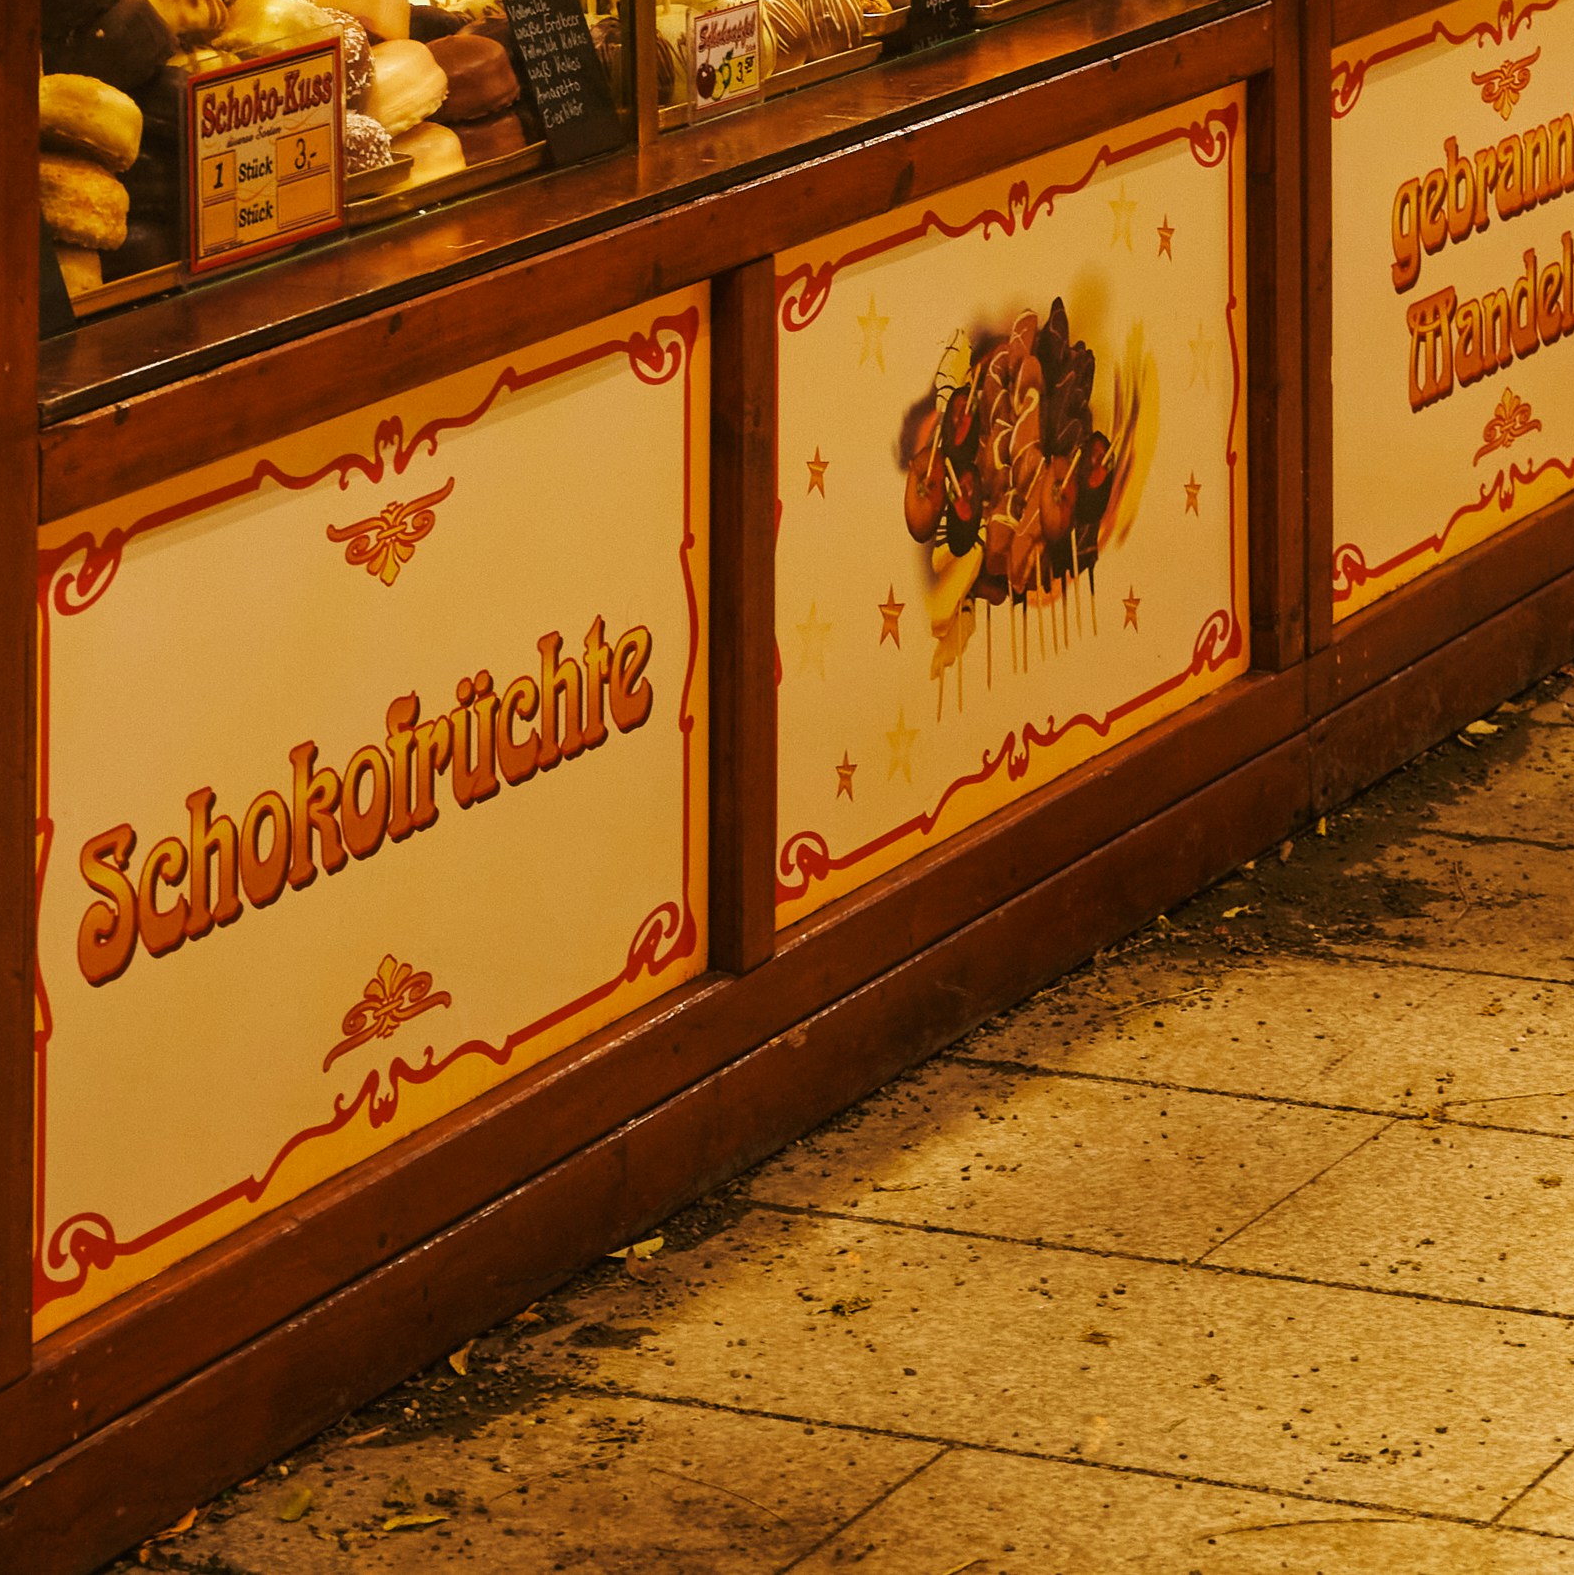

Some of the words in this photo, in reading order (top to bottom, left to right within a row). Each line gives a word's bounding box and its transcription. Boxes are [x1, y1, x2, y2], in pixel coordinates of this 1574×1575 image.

[201, 68, 334, 140] Schoko-Kuss
[213, 161, 224, 190] 1
[238, 156, 273, 183] Stück
[238, 201, 273, 228] Stück
[77, 614, 655, 988] Schokofrüchte
